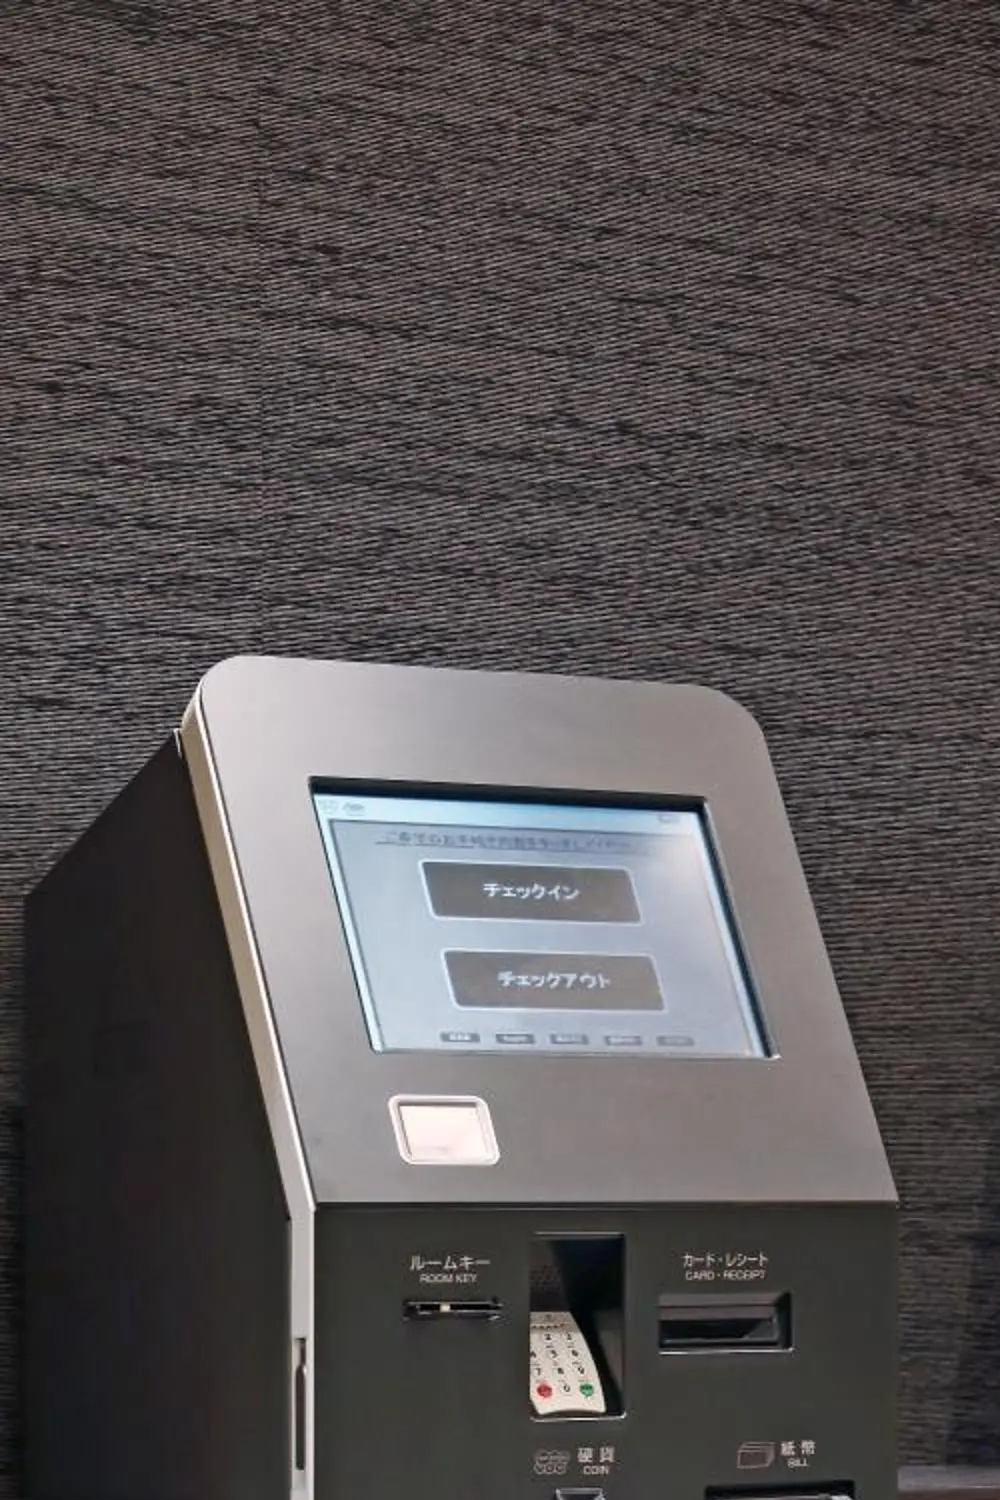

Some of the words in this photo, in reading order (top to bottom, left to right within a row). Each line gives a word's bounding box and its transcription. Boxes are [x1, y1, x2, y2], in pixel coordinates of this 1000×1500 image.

[482, 882, 580, 900] チェックイン
[497, 970, 611, 989] チェックアウト
[409, 1255, 491, 1271] ルームキー
